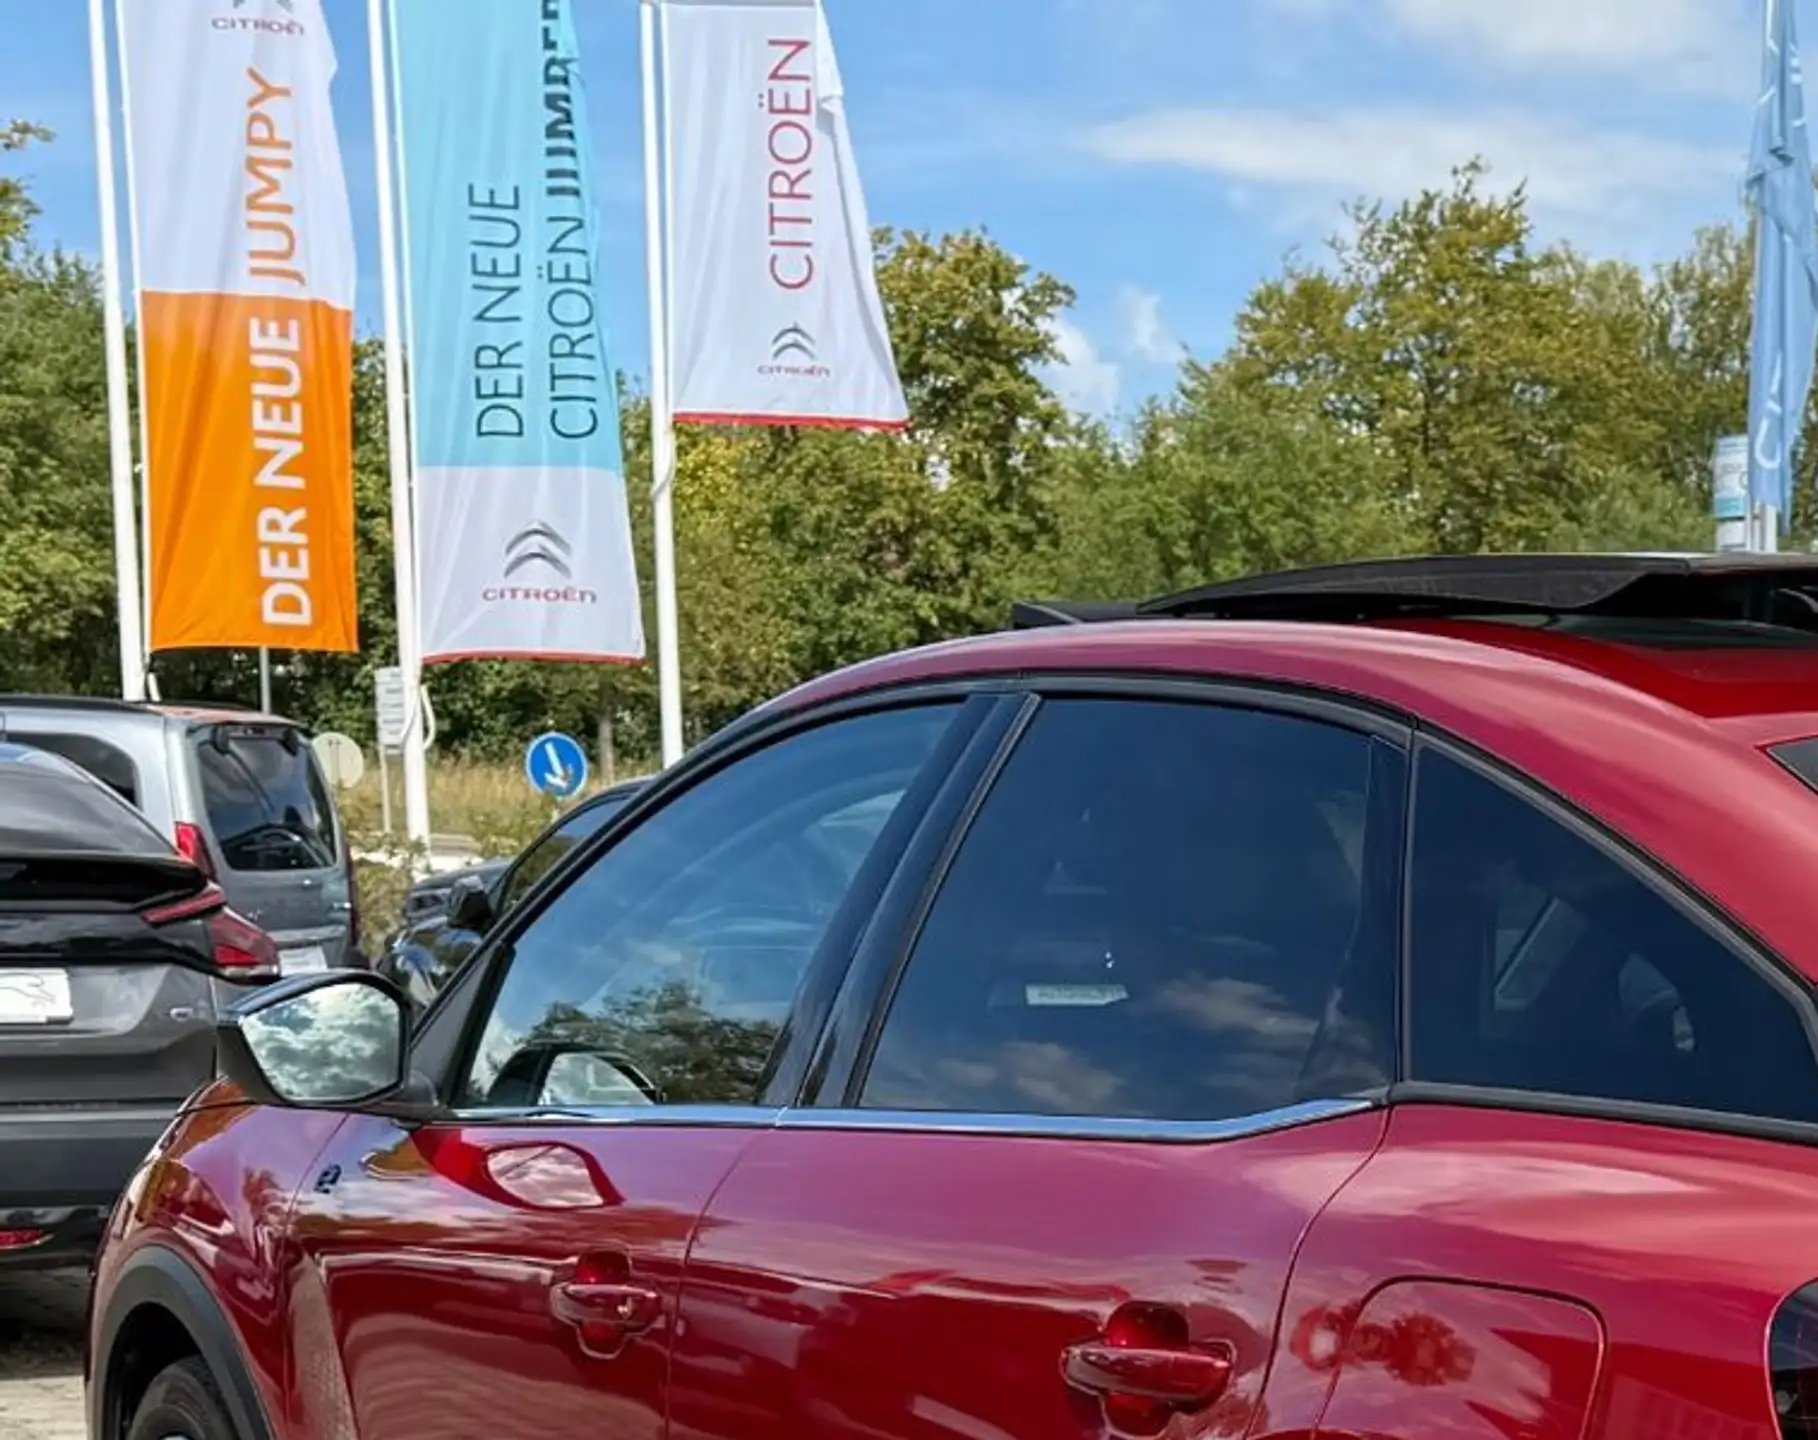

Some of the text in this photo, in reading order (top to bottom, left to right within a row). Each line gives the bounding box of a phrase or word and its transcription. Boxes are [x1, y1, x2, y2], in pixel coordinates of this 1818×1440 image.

[757, 38, 814, 290] CITROËN
[246, 66, 313, 627] DER NEUE JUMPY
[467, 183, 525, 438] DER NEUE
[536, 216, 600, 440] CITROËN
